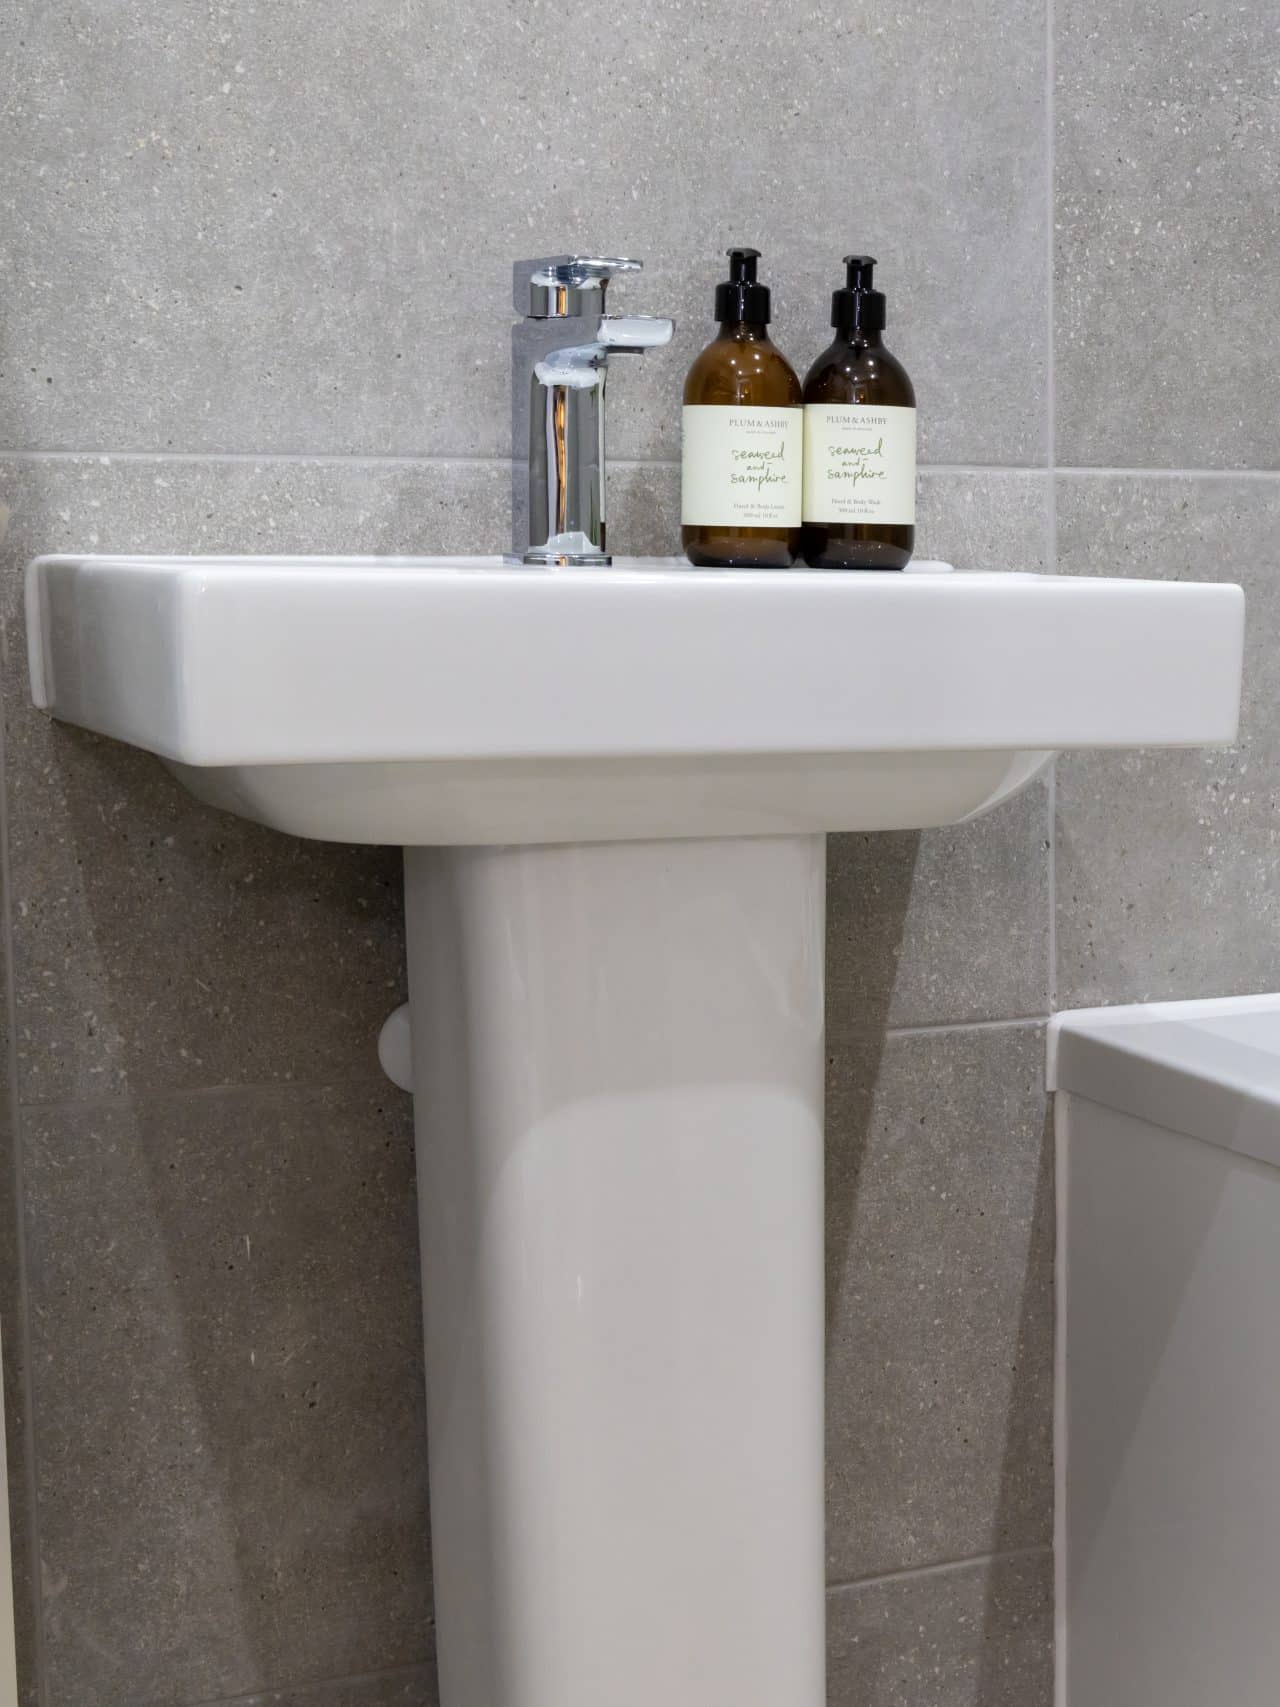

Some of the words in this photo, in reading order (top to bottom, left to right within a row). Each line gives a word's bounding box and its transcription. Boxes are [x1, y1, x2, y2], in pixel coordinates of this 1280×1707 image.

[731, 440, 785, 461] seaweed
[828, 437, 882, 457] seaweed
[746, 461, 765, 471] and
[841, 456, 860, 466] and
[730, 467, 789, 492] samphire
[827, 463, 887, 488] samphire
